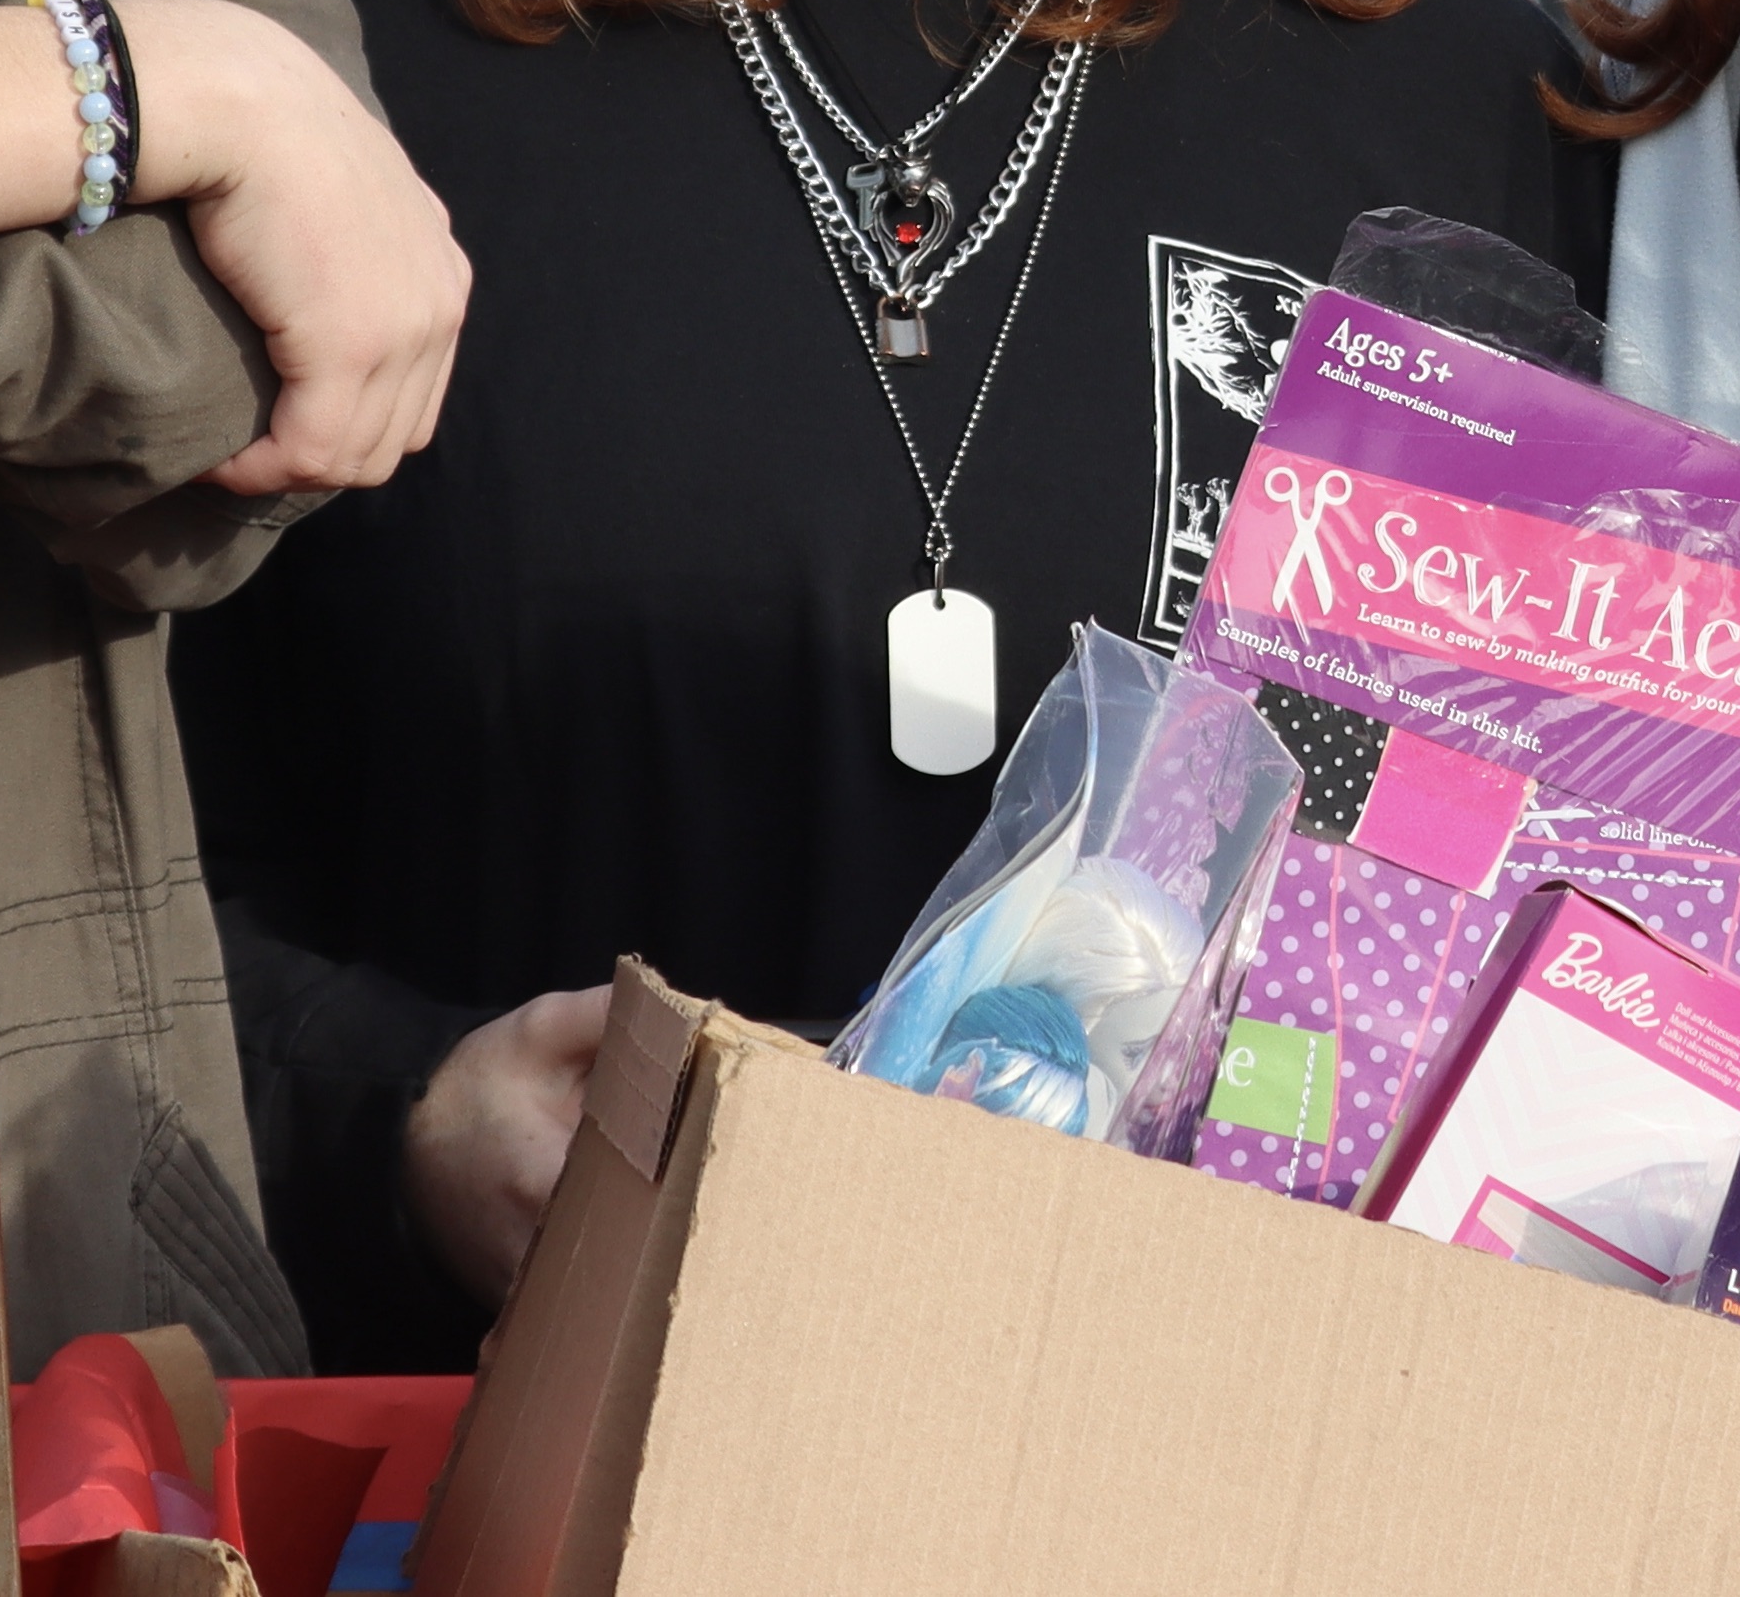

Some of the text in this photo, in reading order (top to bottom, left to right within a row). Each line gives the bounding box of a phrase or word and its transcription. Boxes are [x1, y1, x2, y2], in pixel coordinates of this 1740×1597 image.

[1324, 317, 1453, 383] Ages 5+
[1317, 361, 1517, 446] Adult supervision required
[1358, 511, 1620, 651] Sew-It
[1216, 618, 1544, 754] Samples of fabrics used in this kit.
[1357, 604, 1416, 634] Learn
[1420, 621, 1441, 640] to
[1445, 631, 1483, 651] sew
[1486, 635, 1512, 659] by
[1515, 647, 1593, 682] making
[1594, 665, 1659, 696] outfits
[1662, 681, 1692, 703] for
[1599, 822, 1645, 842] solid
[1648, 825, 1683, 845] line
[1542, 932, 1660, 1028] Barbie
